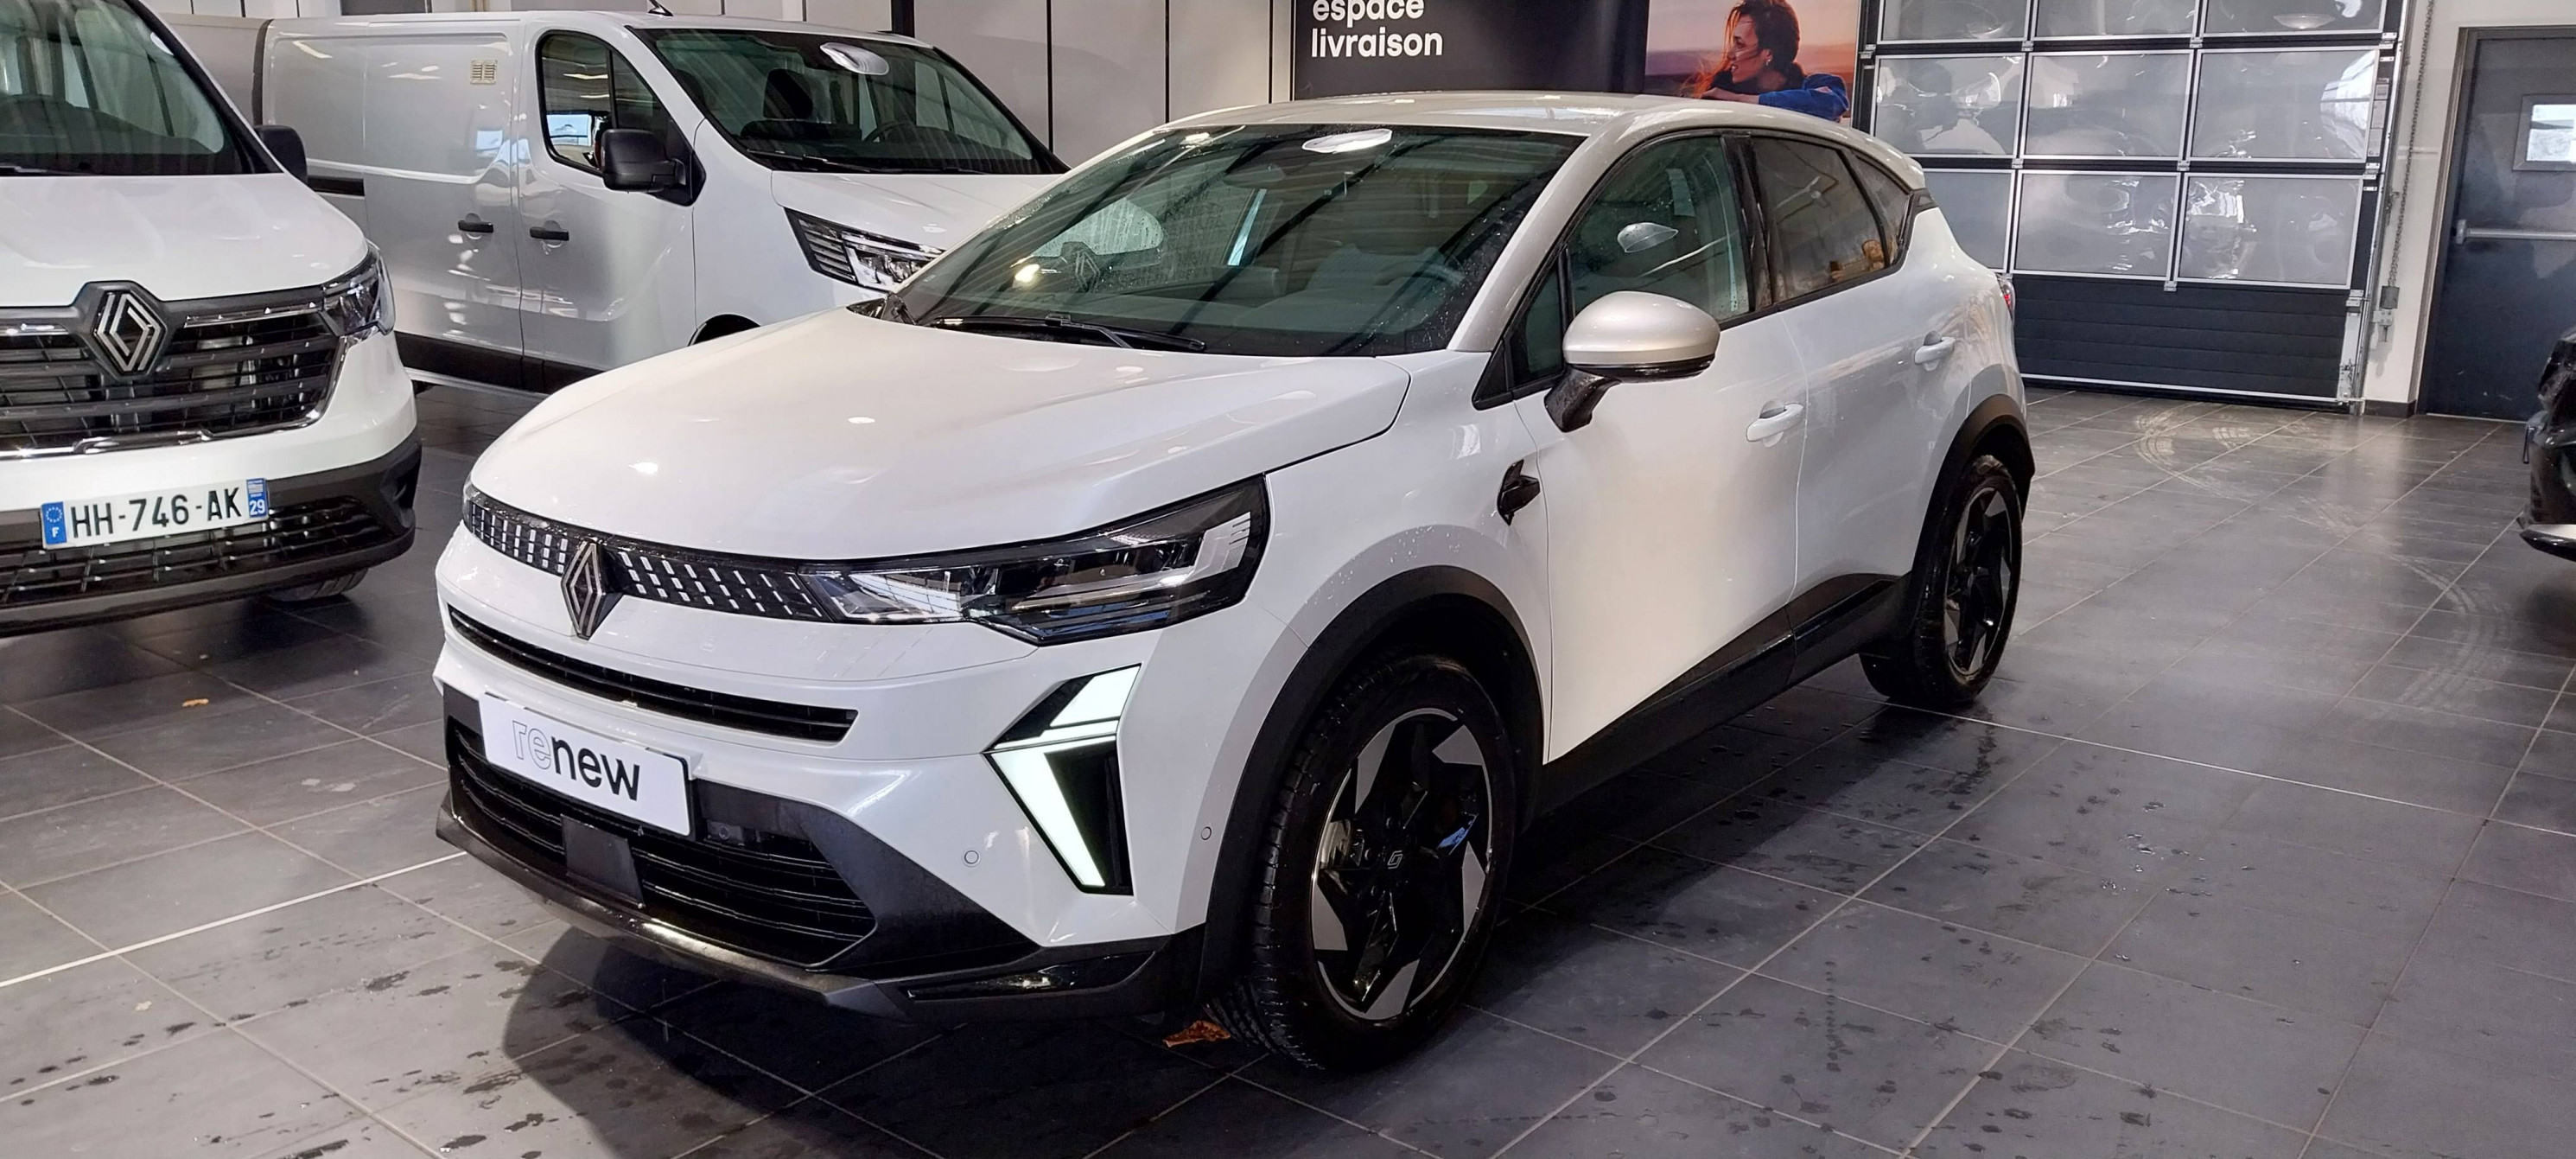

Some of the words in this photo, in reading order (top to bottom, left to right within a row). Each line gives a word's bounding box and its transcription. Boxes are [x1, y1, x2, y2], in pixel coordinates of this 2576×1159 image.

[1313, 0, 1423, 28] espace
[1312, 27, 1442, 57] livraison
[71, 487, 241, 538] HH-746-AK
[249, 499, 266, 516] 29
[52, 526, 60, 538] F
[512, 720, 639, 801] renew
